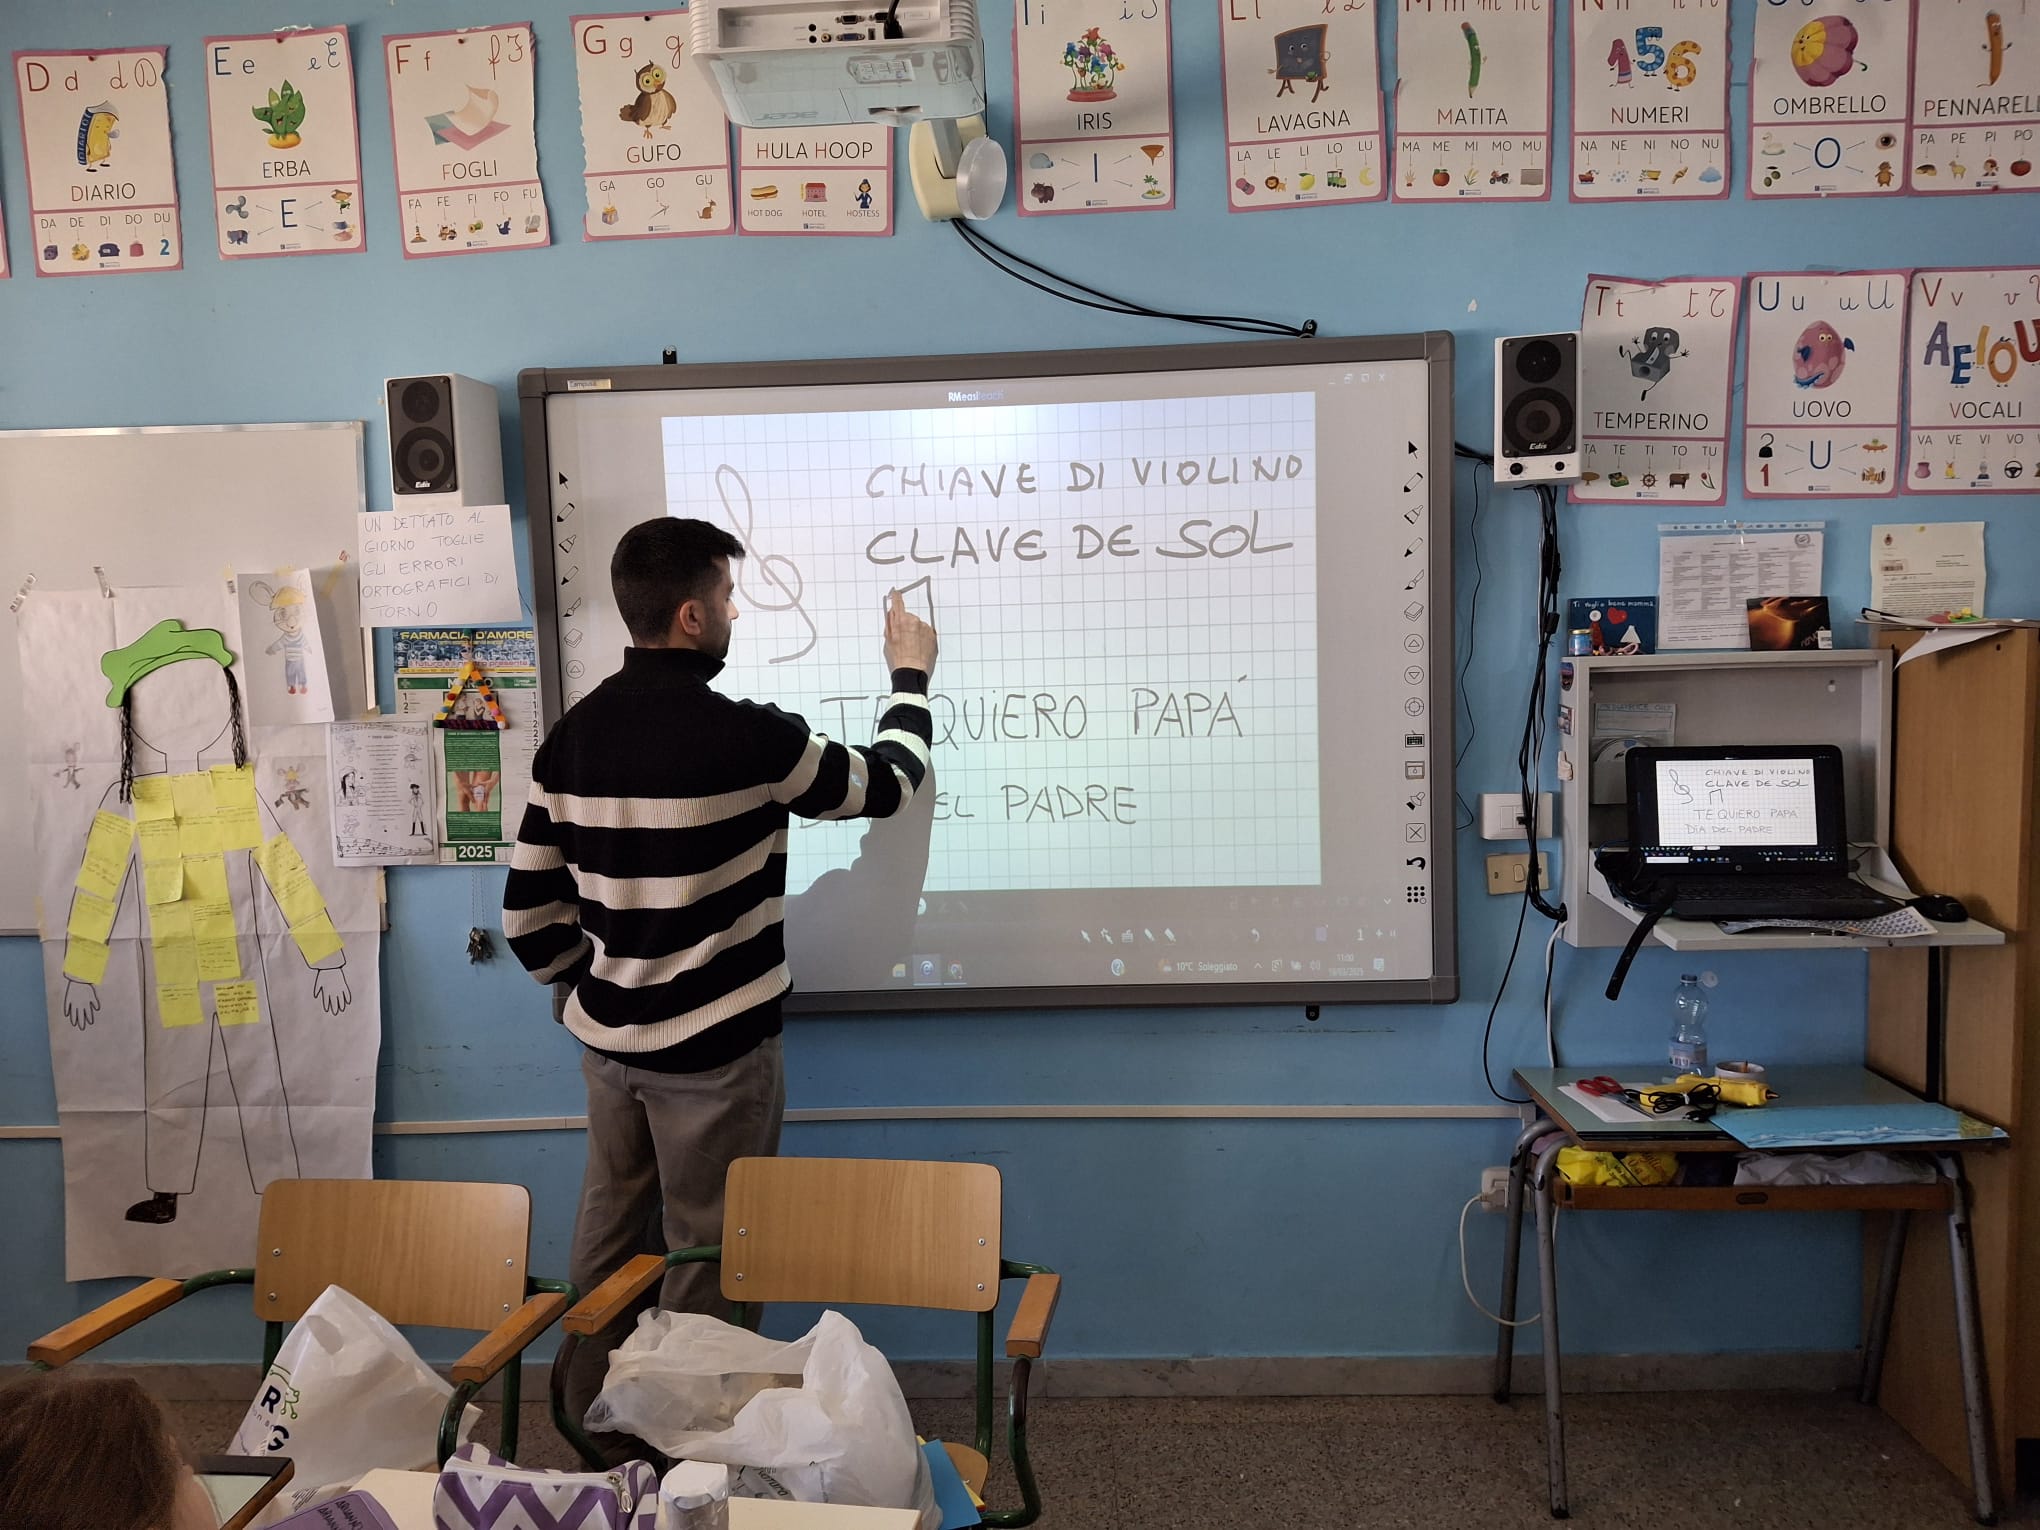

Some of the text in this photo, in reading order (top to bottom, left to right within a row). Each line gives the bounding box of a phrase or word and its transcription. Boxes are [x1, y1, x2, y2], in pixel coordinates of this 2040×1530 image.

[583, 24, 684, 69] G g g
[214, 46, 232, 76] E
[242, 58, 255, 74] e
[307, 57, 321, 71] e
[395, 44, 412, 75] F
[424, 50, 431, 72] f
[26, 57, 157, 92] D d d D
[1611, 106, 1689, 125] NUMERI
[1774, 95, 1886, 116] OMBRELLO
[1077, 112, 1113, 131] IRIS
[1257, 109, 1351, 134] LAVAGNA
[1437, 108, 1508, 126] MATITA
[1402, 140, 1542, 152] MA ME MI MO MU
[1580, 138, 1719, 152] NA NE NI NO NU
[1919, 129, 2034, 146] PA PE PI PO
[626, 143, 681, 164] GUFO
[756, 141, 873, 159] HULA HOOP
[1237, 140, 1373, 162] LA LE LI LO LU
[1814, 137, 1841, 169] O
[262, 159, 311, 179] ERBA
[442, 159, 498, 181] FOGLI
[71, 182, 136, 202] DIARIO
[599, 174, 713, 192] GA GO GU
[408, 188, 537, 209] FA FE FI FO FU
[41, 212, 171, 229] DA DE DI DO DU
[281, 199, 298, 229] E
[747, 209, 783, 217] HOT DOG
[802, 209, 827, 217] HOTEL
[846, 209, 880, 218] HOSTESS
[1596, 286, 1610, 317] T
[1616, 299, 1624, 317] t
[1758, 279, 1895, 311] U u u U
[1921, 277, 1943, 307] V
[1952, 291, 1963, 306] v
[1793, 401, 1852, 418] UOVO
[1950, 401, 2022, 420] VOCALI
[1594, 412, 1709, 431] TEMPERINO
[1917, 433, 2024, 446] VA VE VI VO
[1584, 443, 1717, 457] TA TE TI TO TU
[1810, 439, 1832, 470] U
[865, 454, 1303, 500] CHIAVE DI VIOLINO
[364, 511, 486, 533] UN DETTATO AL
[364, 533, 486, 553] GIORNO TOGLIE
[866, 509, 1294, 569] CLAVE DE SOL
[363, 556, 465, 577] GLI ERRORI
[361, 572, 500, 599] ORTOGRAFICI DI
[369, 601, 438, 619] TORNO
[400, 630, 534, 640] FARMACIA D'AMORE
[1131, 674, 1248, 739] PAPÁ
[1705, 767, 1811, 777] CHIAVE DI VIOLINO
[1705, 778, 1809, 788] CLAVE DE SOL
[999, 783, 1138, 825] PADRE
[1693, 809, 1714, 821] TE
[1739, 825, 1775, 835] PADRE
[458, 845, 493, 859] 2025
